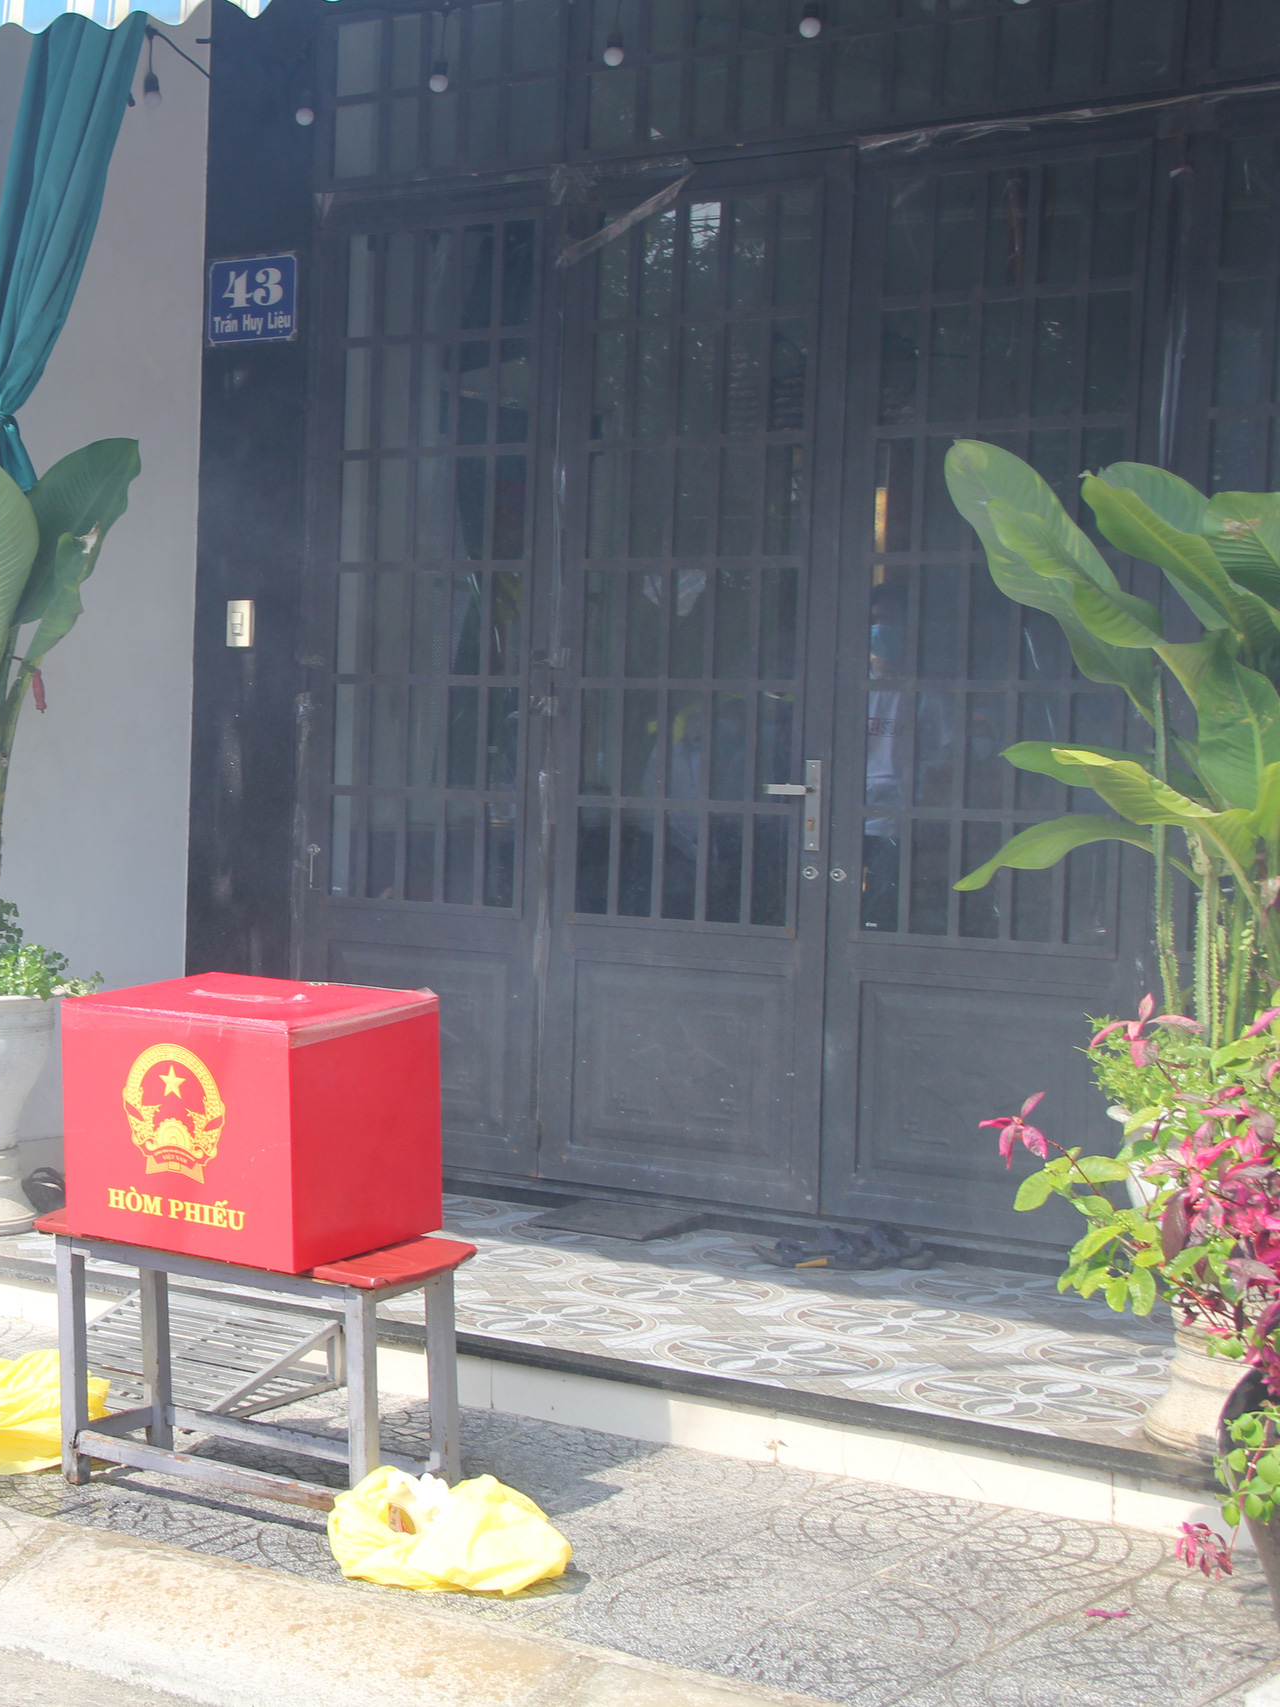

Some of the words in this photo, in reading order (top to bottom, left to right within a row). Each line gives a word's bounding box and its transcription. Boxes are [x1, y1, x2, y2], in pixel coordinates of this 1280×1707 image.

[222, 268, 283, 308] 43
[242, 314, 263, 335] Huy
[267, 310, 291, 334] Liệu
[107, 1185, 163, 1216] HÒM
[167, 1199, 246, 1231] PHIẾU
